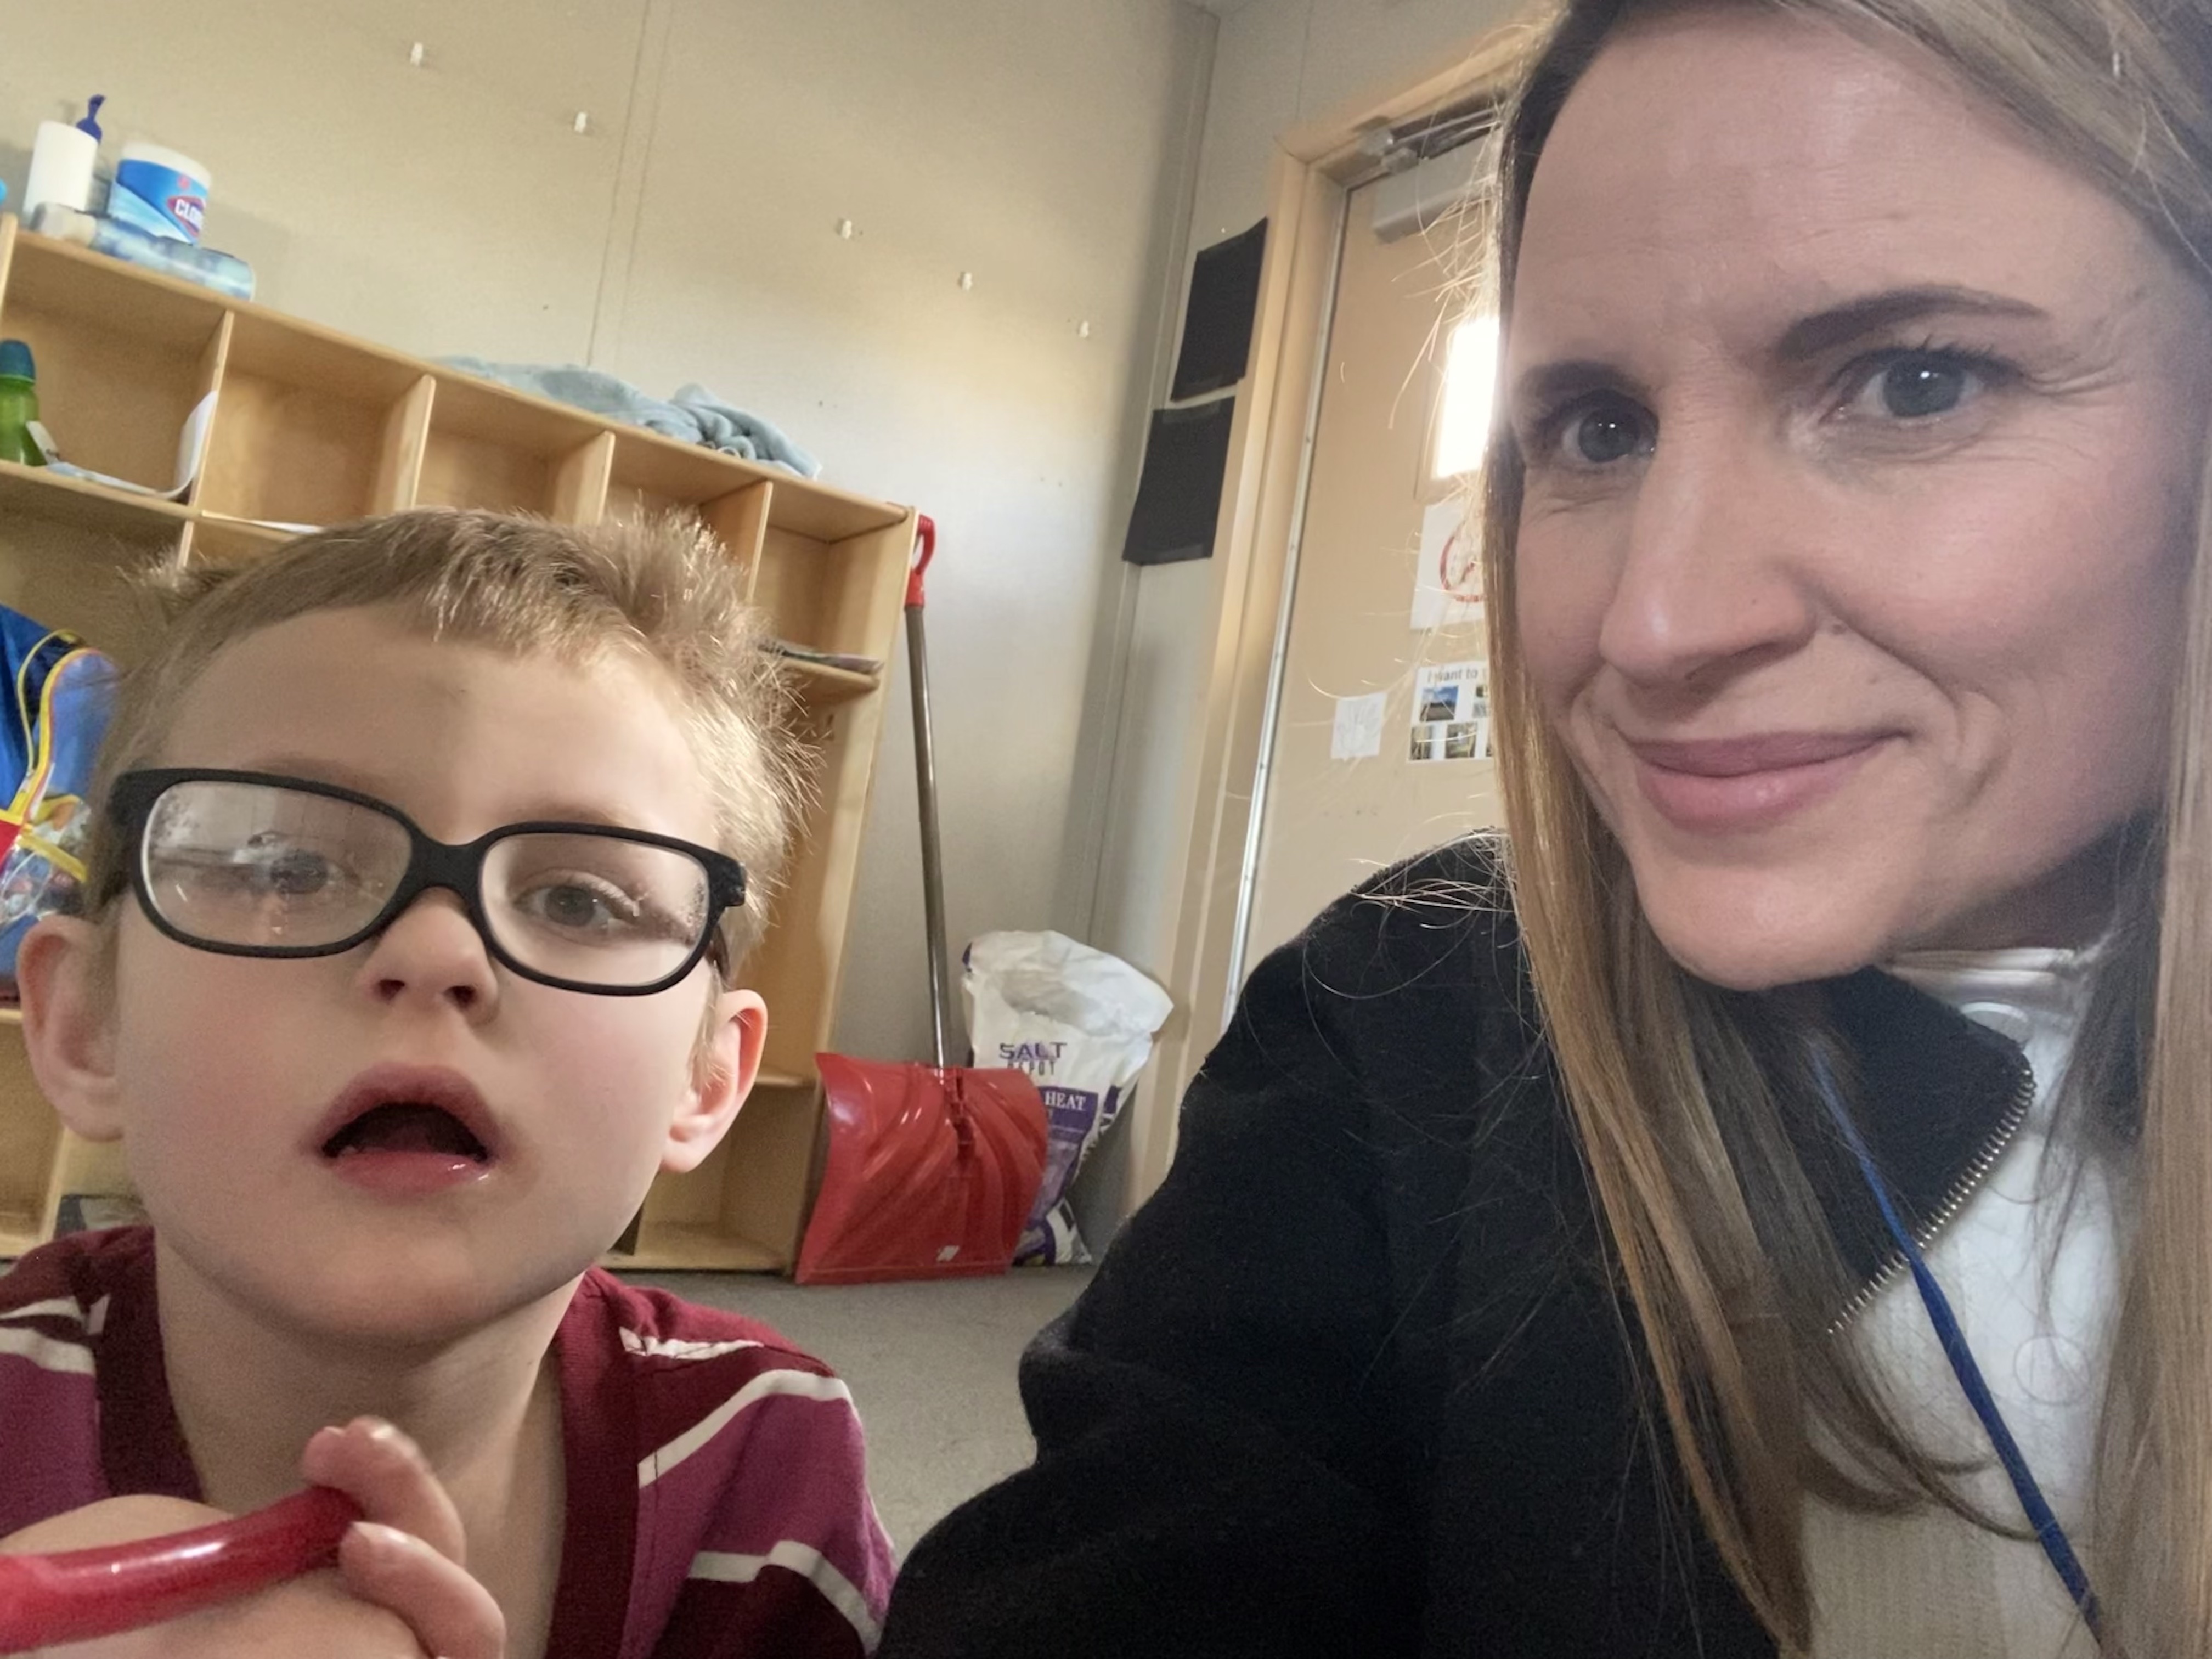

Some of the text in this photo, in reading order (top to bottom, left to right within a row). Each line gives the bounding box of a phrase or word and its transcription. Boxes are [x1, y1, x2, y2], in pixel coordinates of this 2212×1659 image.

[1465, 667, 1479, 680] to
[999, 1042, 1068, 1060] SALT
[1044, 1090, 1087, 1111] HEAT
